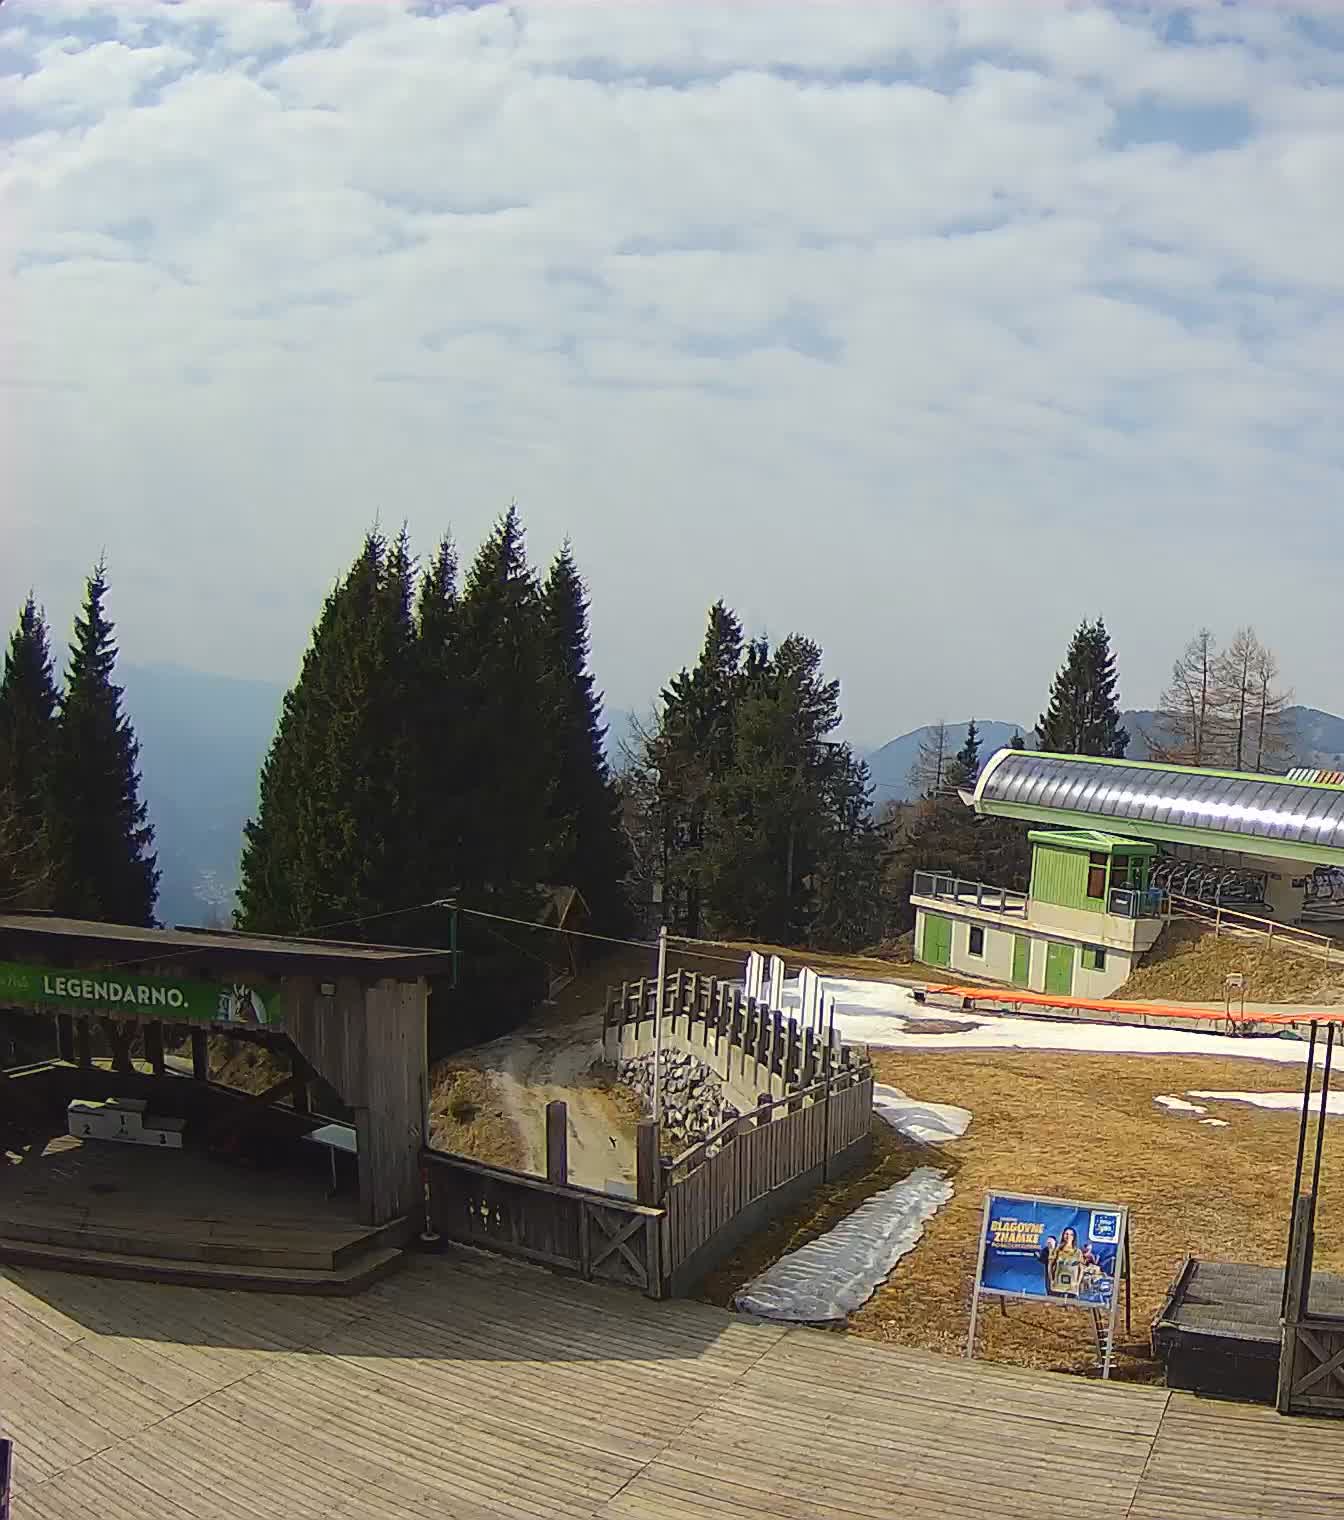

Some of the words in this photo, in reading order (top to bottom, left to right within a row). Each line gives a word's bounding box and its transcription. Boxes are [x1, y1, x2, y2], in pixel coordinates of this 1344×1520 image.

[43, 975, 189, 1009] LEGENDARNO.
[160, 1133, 167, 1145] 3
[993, 1231, 1039, 1244] ZNAMKE
